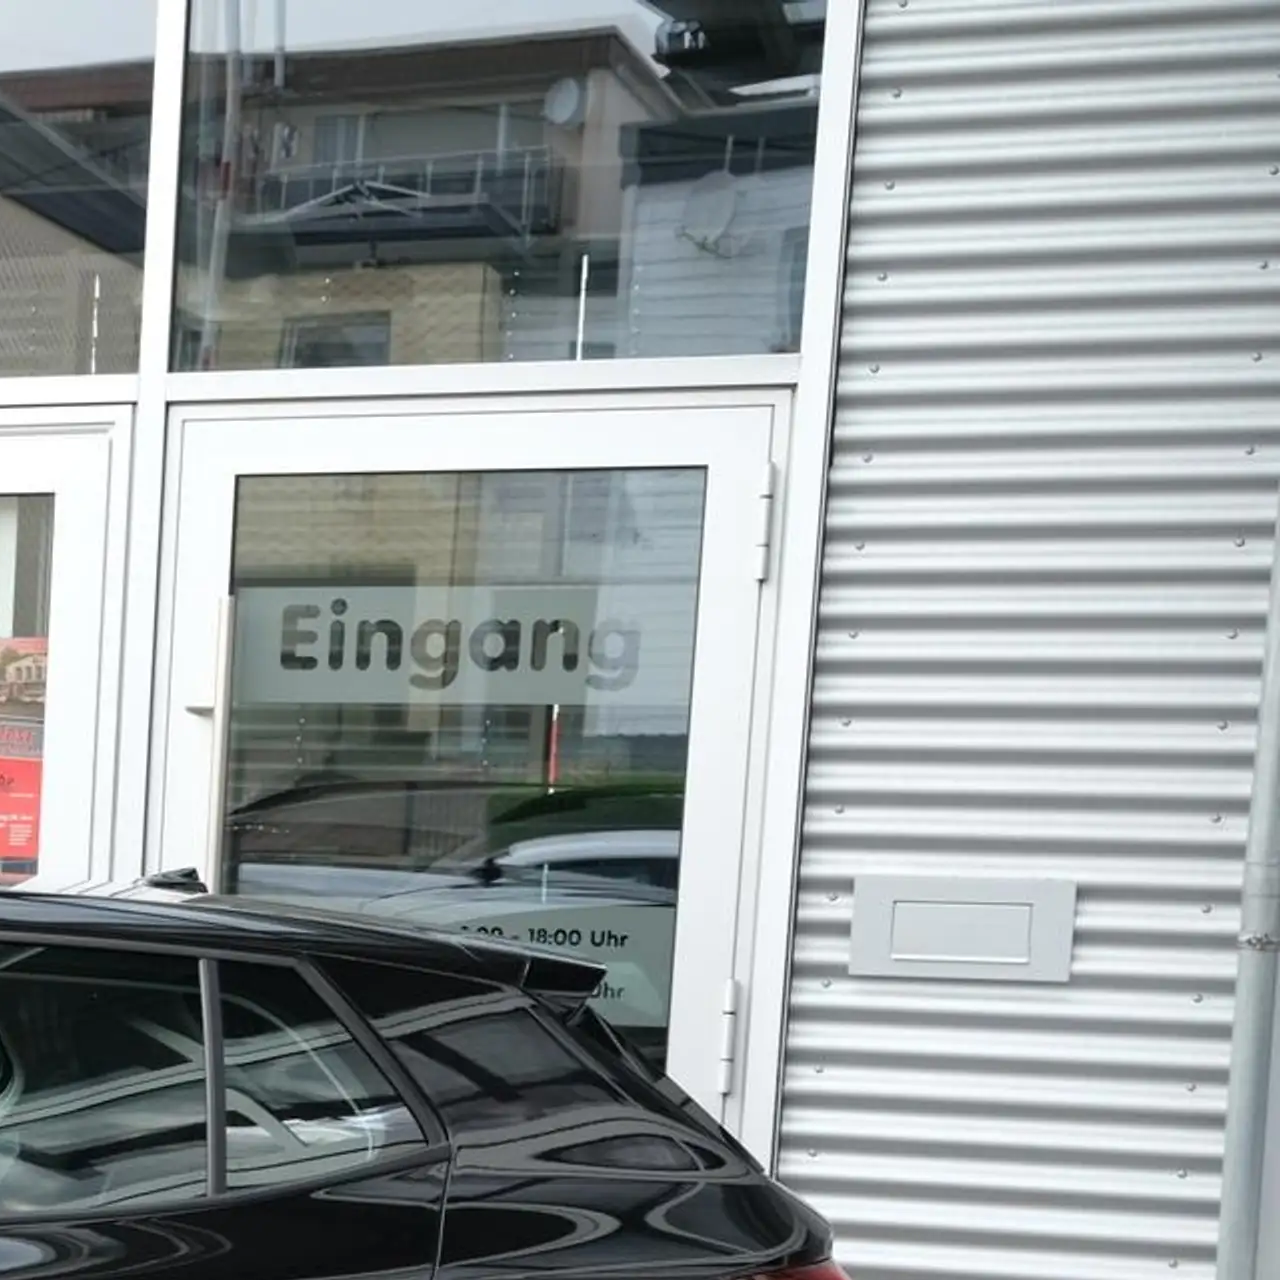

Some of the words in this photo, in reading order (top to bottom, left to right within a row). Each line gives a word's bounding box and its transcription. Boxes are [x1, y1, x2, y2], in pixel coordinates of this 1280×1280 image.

[279, 597, 642, 691] Eingang
[528, 927, 582, 946] 18:00
[590, 930, 630, 948] Uhr
